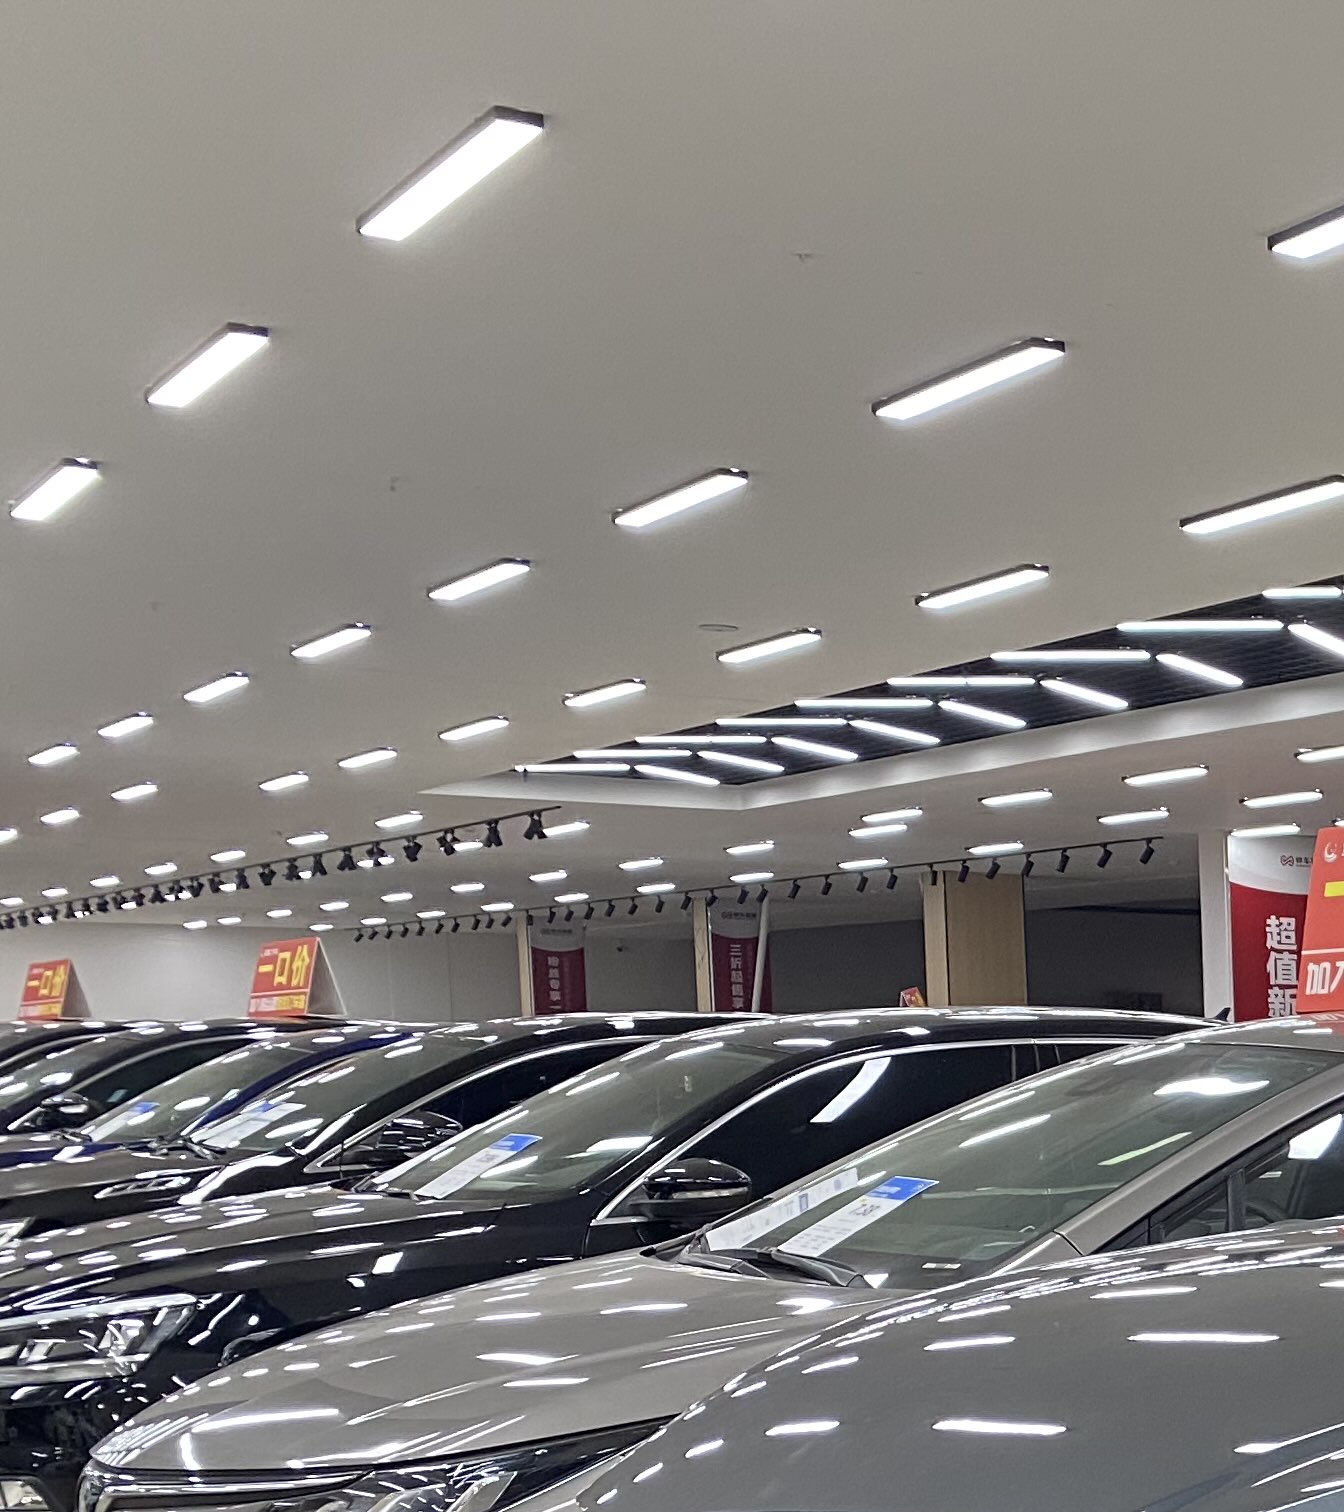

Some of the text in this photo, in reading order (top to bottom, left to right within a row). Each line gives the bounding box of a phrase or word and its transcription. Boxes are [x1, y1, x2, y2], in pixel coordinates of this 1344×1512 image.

[26, 964, 66, 998] 一口价
[257, 944, 310, 987] 一口价
[1265, 915, 1298, 1018] 超值新
